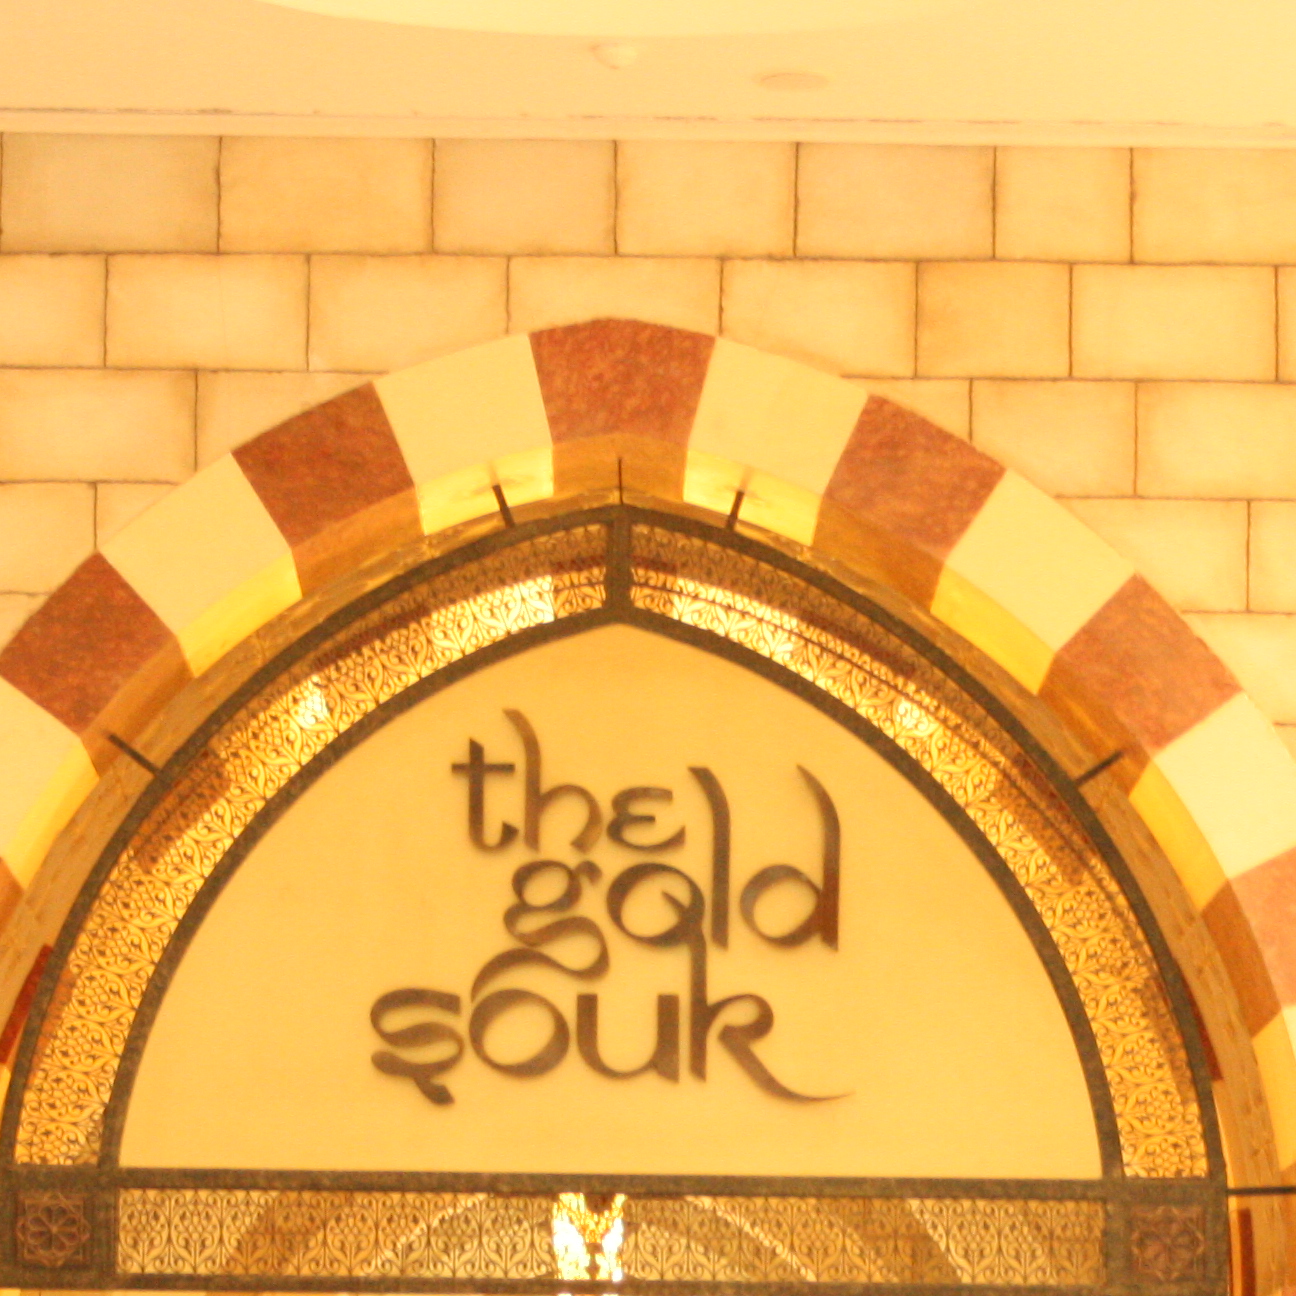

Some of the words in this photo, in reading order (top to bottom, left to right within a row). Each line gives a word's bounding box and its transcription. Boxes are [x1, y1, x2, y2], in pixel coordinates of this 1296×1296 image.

[451, 708, 686, 854] the
[471, 764, 842, 1001] gold
[369, 925, 856, 1106] souk
